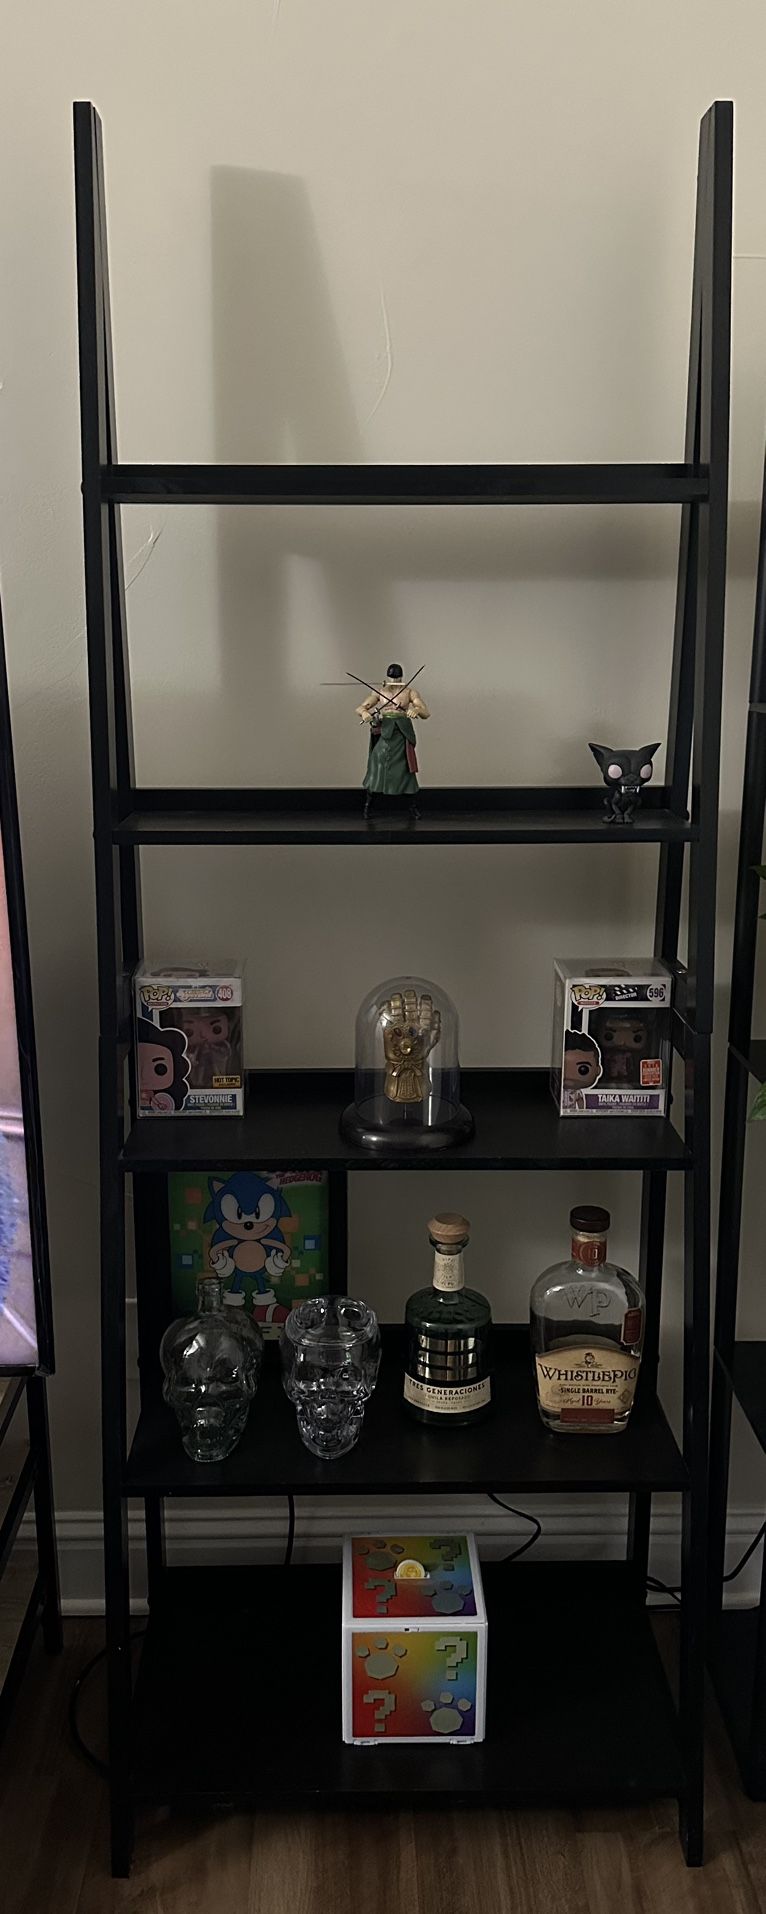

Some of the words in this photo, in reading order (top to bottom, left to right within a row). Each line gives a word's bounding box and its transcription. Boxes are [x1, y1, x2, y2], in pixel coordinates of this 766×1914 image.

[140, 985, 173, 1002] POP!
[218, 987, 233, 999] 408
[570, 985, 605, 1001] POP!
[649, 988, 664, 998] 596
[189, 1095, 233, 1104] STEVONNIE
[597, 1094, 619, 1103] TAIKA
[620, 1094, 650, 1103] WAITITI
[563, 1286, 612, 1317] WP
[408, 1379, 424, 1390] TRES
[426, 1384, 485, 1396] GENERACIONES
[582, 1395, 593, 1406] 10
